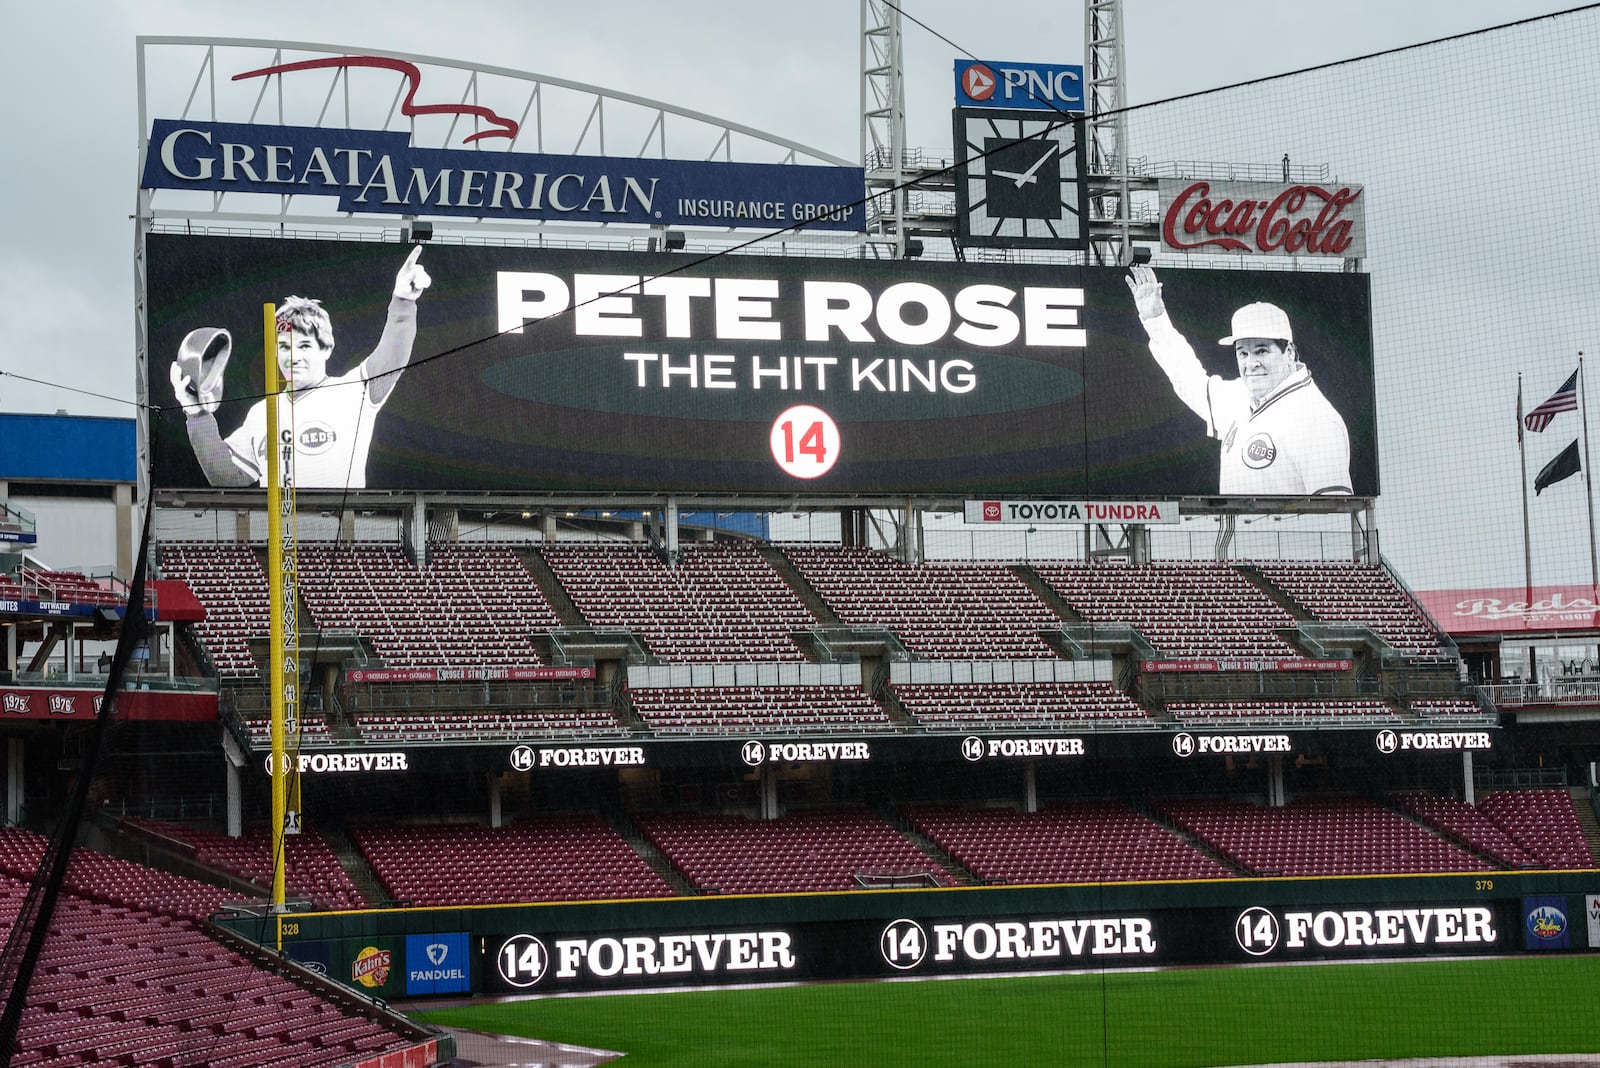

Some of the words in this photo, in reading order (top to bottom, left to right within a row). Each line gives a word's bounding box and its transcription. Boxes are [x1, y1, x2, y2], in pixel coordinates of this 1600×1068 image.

[1000, 68, 1080, 102] PNC
[161, 128, 372, 188] GREAT
[353, 154, 660, 217] AMERICAN
[678, 198, 786, 220] INSURANCE
[792, 203, 854, 222] GROUP
[1163, 182, 1364, 254] Coca-Cola
[496, 270, 782, 342] PETE
[804, 280, 1087, 349] ROSE
[623, 352, 737, 390] THE
[752, 355, 838, 392] HIT
[851, 358, 978, 395] KING
[301, 431, 336, 444] REDS
[779, 419, 828, 465] 14
[1249, 444, 1274, 460] REDS
[1008, 503, 1081, 520] TOYOTA
[1084, 504, 1161, 520] TUNDRA
[40, 602, 70, 611] CUTWATER
[1453, 593, 1600, 620] Reds
[437, 668, 465, 680] KROGER
[5, 695, 25, 711] 1975
[51, 696, 71, 712] 1976
[964, 739, 982, 757] 14
[988, 738, 1085, 758] FOREVER
[1175, 736, 1192, 753] 14
[1198, 734, 1292, 753] FOREVER
[1378, 733, 1395, 750] 14
[1401, 732, 1492, 750] FOREVER
[513, 748, 532, 769] 14
[539, 746, 646, 767] FOREVER
[744, 743, 763, 762] 14
[769, 742, 870, 762] FOREVER
[296, 752, 408, 773] FOREVER
[1475, 880, 1494, 891] 379
[282, 923, 300, 936] 328
[1240, 913, 1274, 949] 14
[1285, 907, 1497, 949] FOREVER
[885, 925, 921, 962] 14
[933, 917, 1157, 962] FOREVER
[354, 952, 390, 978] Kahn's
[503, 941, 542, 980] 14
[556, 931, 796, 979] FOREVER
[410, 969, 465, 982] FANDUEL
